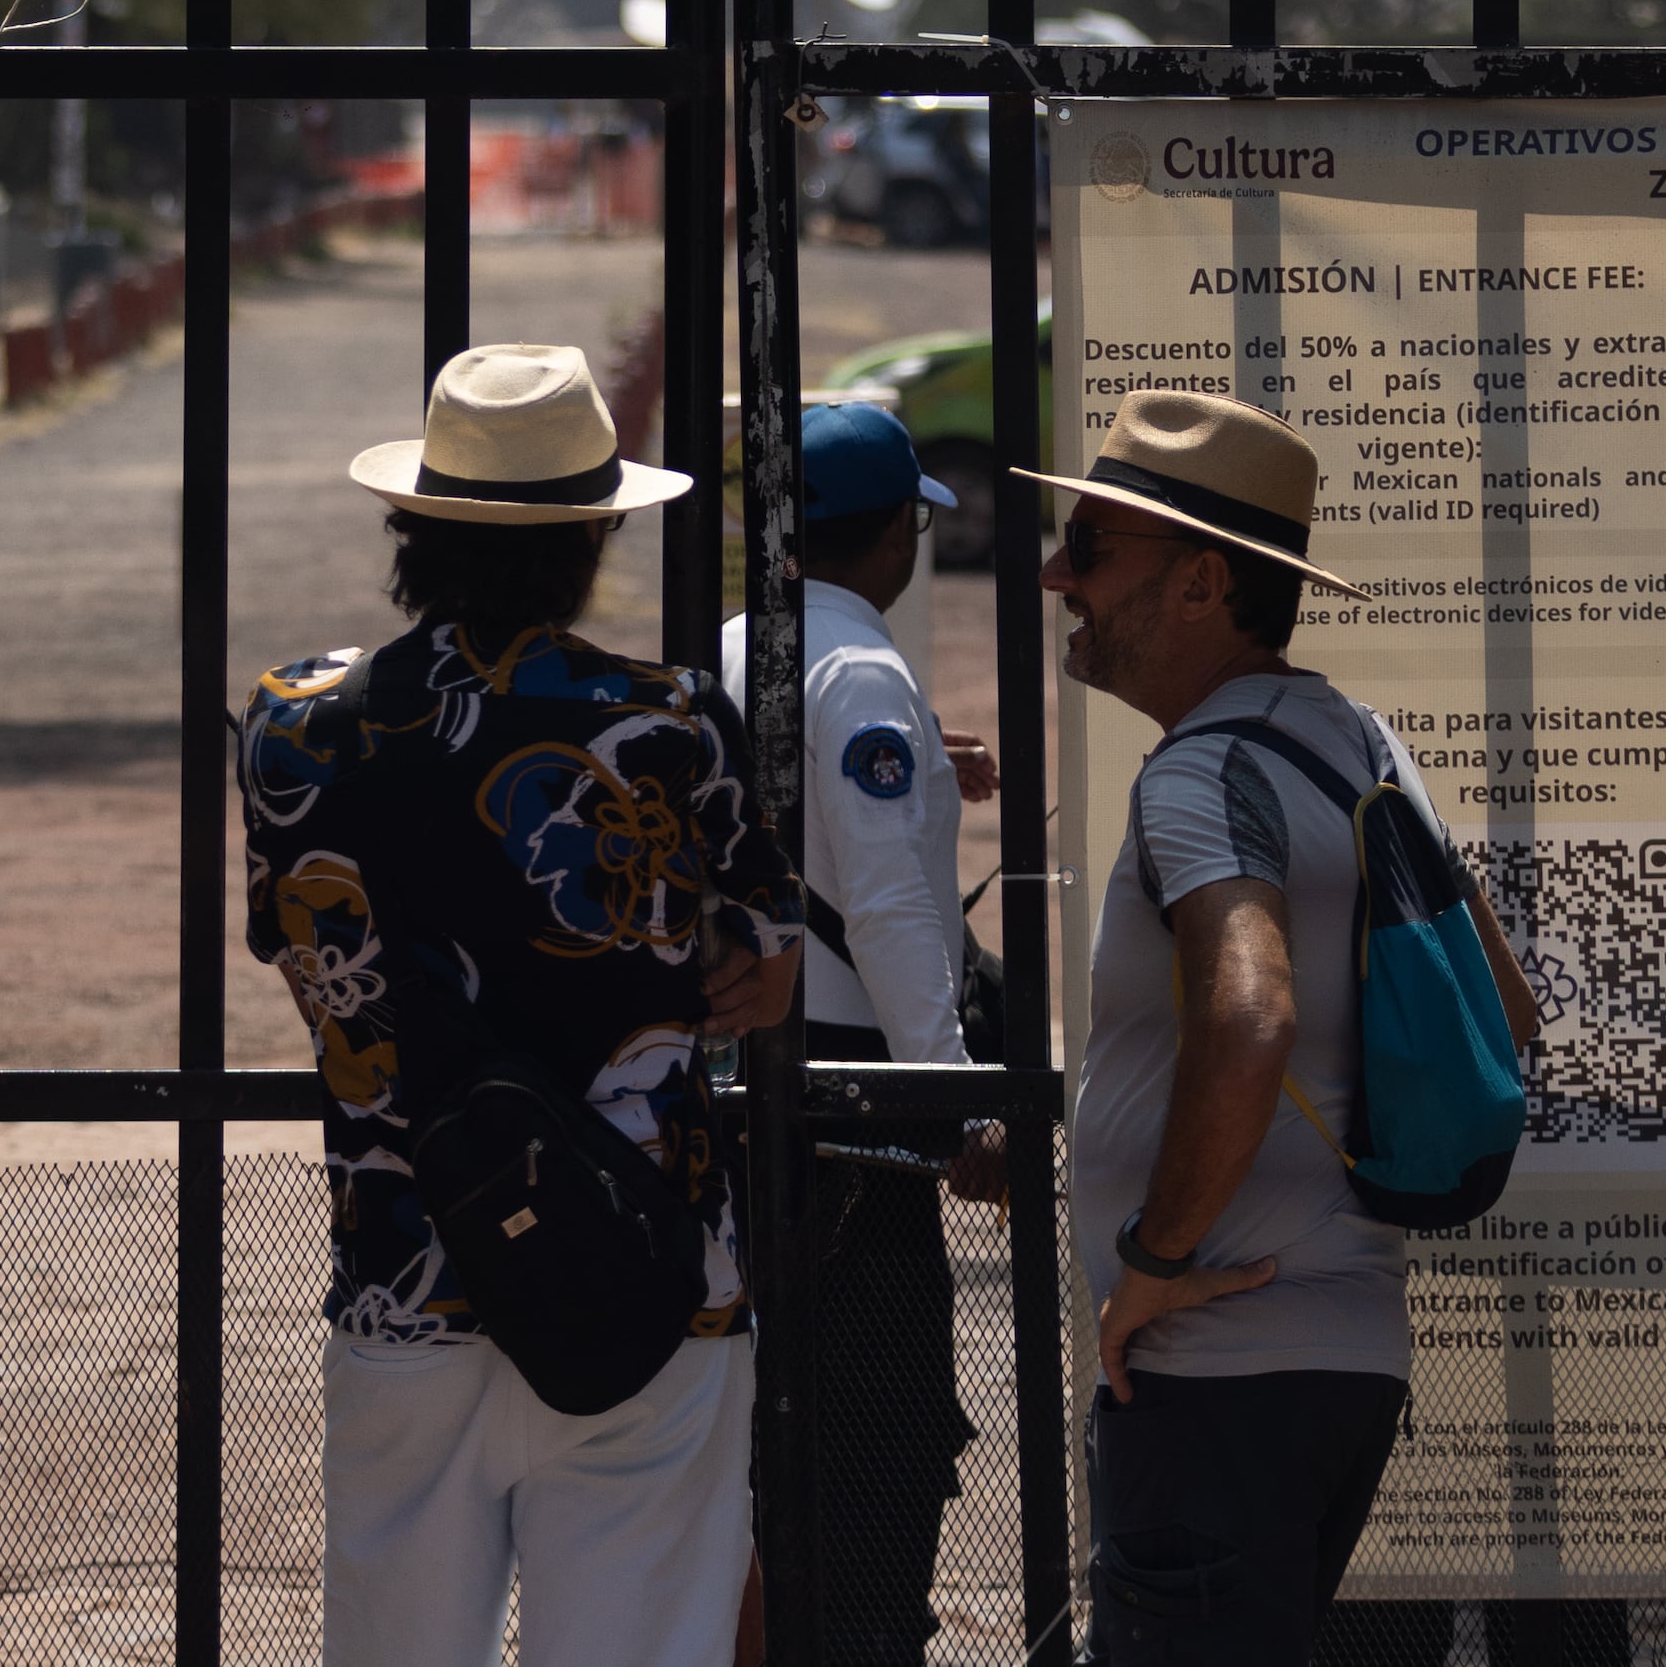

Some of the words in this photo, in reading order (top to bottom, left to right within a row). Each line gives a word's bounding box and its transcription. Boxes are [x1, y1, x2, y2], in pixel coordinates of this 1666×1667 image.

[1416, 127, 1656, 157] OPERATIVOS
[1164, 136, 1334, 179] Cultura
[1164, 188, 1217, 198] Secretaría
[1220, 188, 1232, 198] de
[1235, 188, 1274, 197] Cultura
[1189, 259, 1375, 295] ADMISIÓN
[1419, 267, 1577, 292] ENTRANCE
[1588, 266, 1644, 289] FEE:
[1085, 339, 1231, 360] Descuento
[1245, 336, 1286, 359] del
[1301, 336, 1357, 358] 50%
[1371, 340, 1385, 357] a
[1401, 333, 1551, 356] nacionales
[1564, 338, 1580, 361] y
[1085, 372, 1230, 394] residentes
[1262, 376, 1295, 393] en
[1329, 369, 1351, 392] el
[1385, 368, 1441, 398] país
[1474, 372, 1525, 396] que
[1302, 403, 1445, 427] residencia
[1457, 394, 1659, 428] (identificación
[1358, 437, 1481, 466] vigente):
[1354, 470, 1457, 491] Mexican
[1483, 466, 1601, 488] nationals
[1369, 499, 1438, 525] (valid
[1446, 500, 1473, 520] ID
[1483, 497, 1599, 525] required)
[1453, 575, 1593, 595] electrónicos
[1600, 574, 1627, 593] de
[1338, 606, 1361, 624] of
[1367, 605, 1480, 624] electronic
[1488, 604, 1572, 622] devices
[1579, 602, 1612, 621] for
[1446, 713, 1511, 739] para
[1496, 749, 1513, 774] y
[1523, 749, 1578, 773] que
[1460, 773, 1616, 810] requisitos:
[1482, 1215, 1548, 1240] libre
[1558, 1221, 1574, 1239] a
[1431, 1251, 1636, 1277] identificación
[1535, 1292, 1564, 1313] to
[1511, 1325, 1577, 1349] with
[1587, 1322, 1659, 1348] valid
